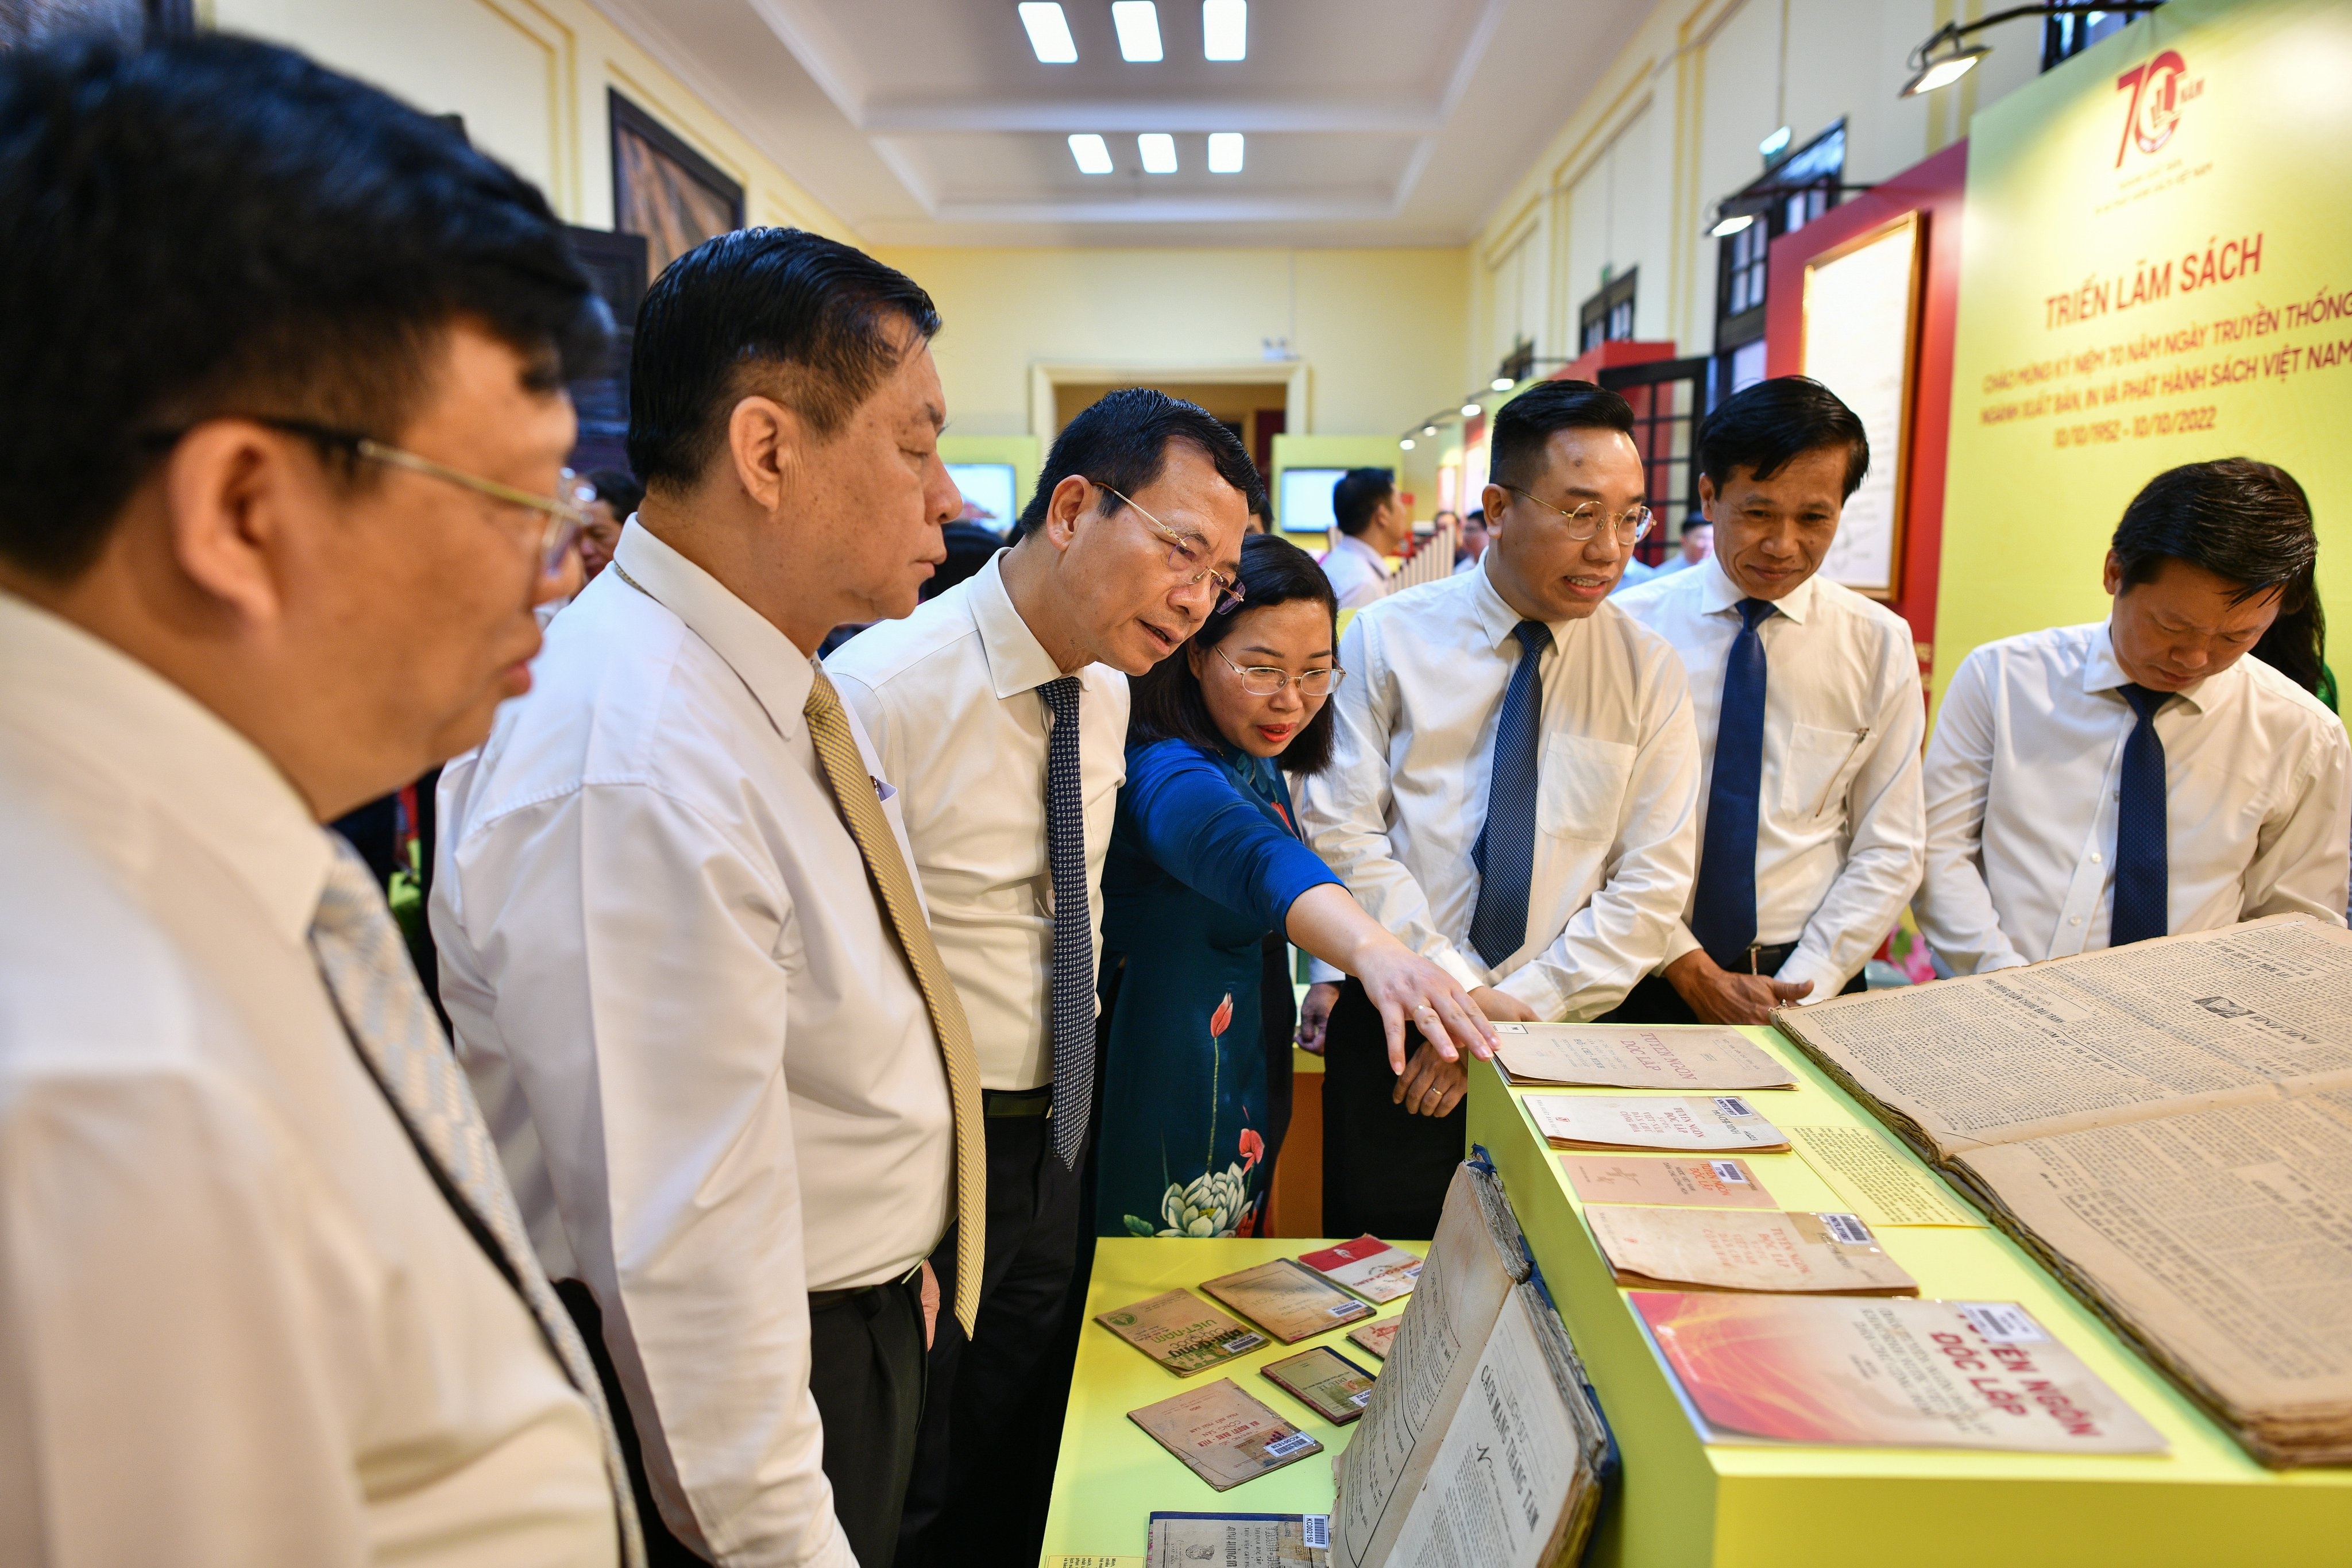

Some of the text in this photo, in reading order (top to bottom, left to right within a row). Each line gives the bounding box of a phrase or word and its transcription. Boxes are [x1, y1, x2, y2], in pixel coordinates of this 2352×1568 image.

[2045, 232, 2264, 331] TRIỂN LÃM SÁCH
[2164, 322, 2208, 353] NGÀY
[2214, 300, 2281, 343] TRUYỀN
[2210, 354, 2258, 388] SÁCH
[2264, 343, 2303, 384] VIỆT
[2307, 338, 2352, 370] NAM
[1477, 1359, 1500, 1405] CÁCH
[1488, 1396, 1512, 1448] MẠNG
[1306, 1518, 1314, 1543] KC002150
